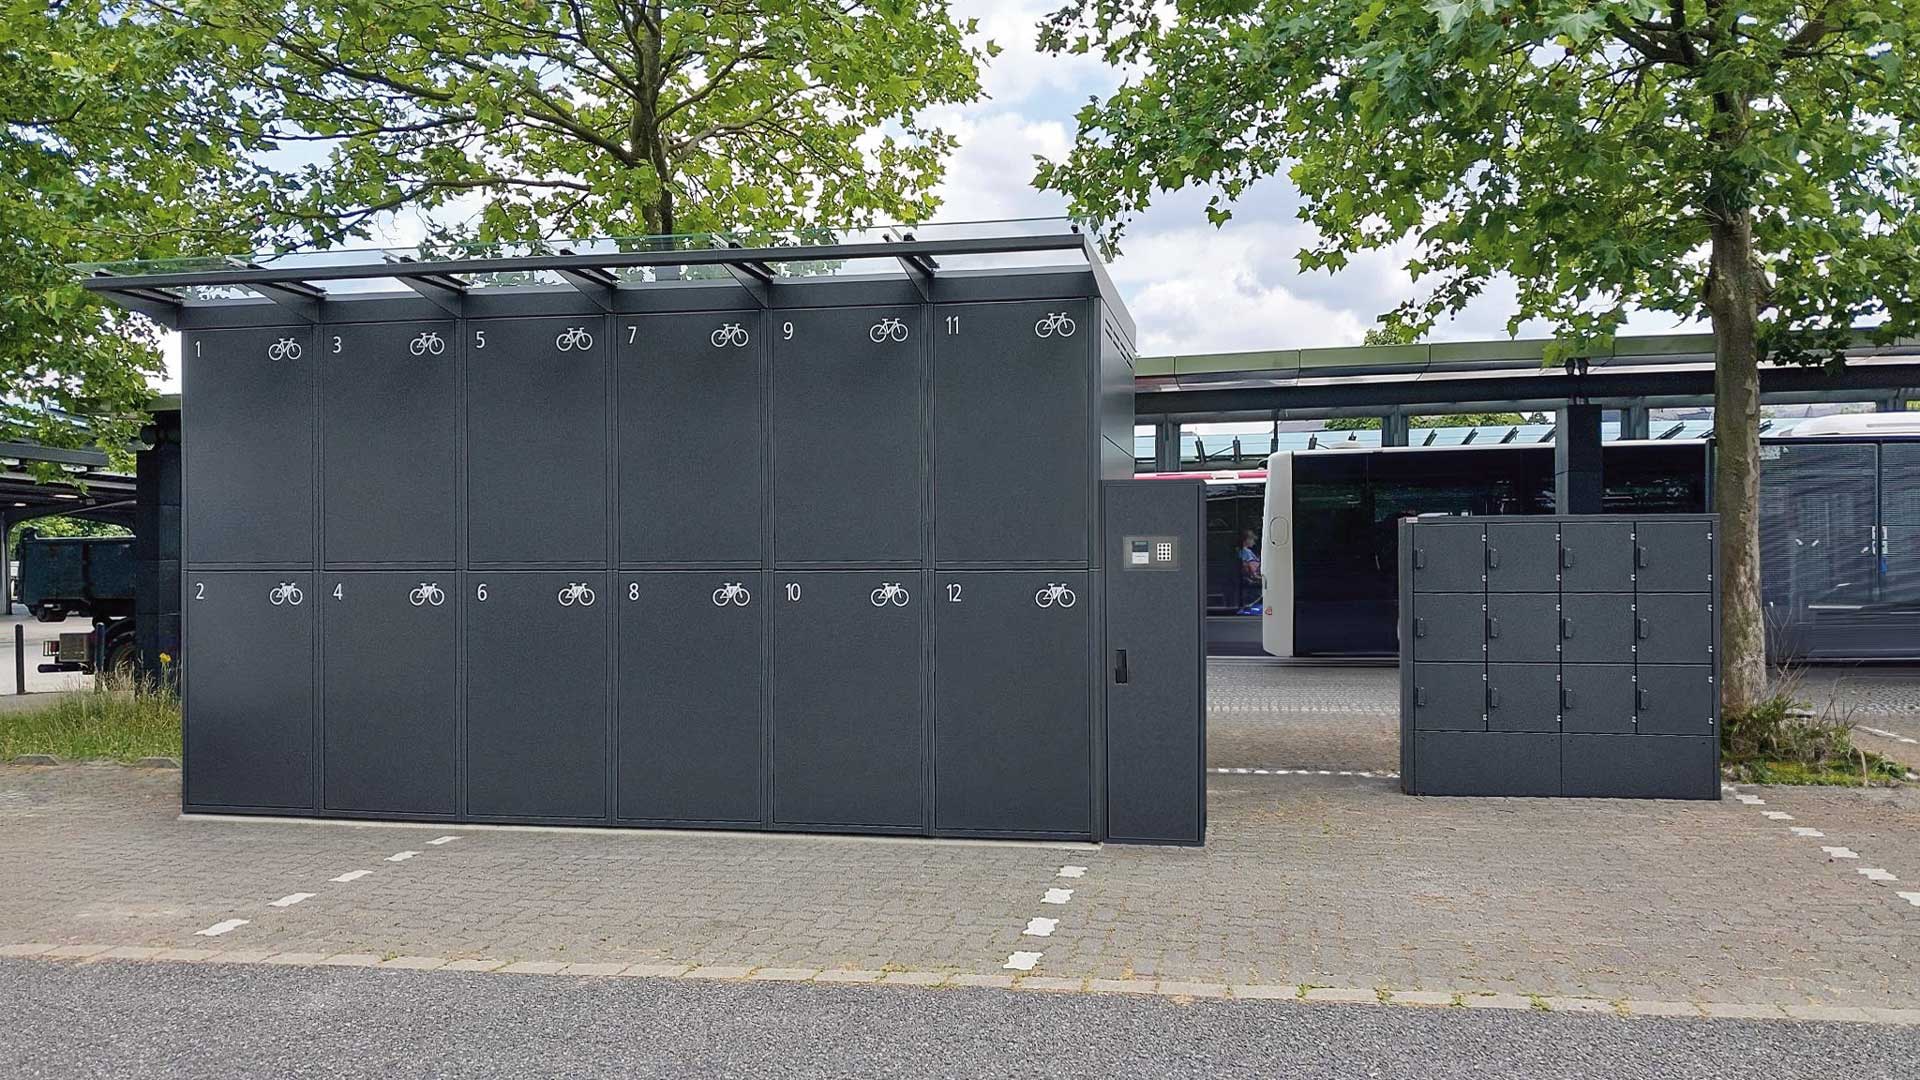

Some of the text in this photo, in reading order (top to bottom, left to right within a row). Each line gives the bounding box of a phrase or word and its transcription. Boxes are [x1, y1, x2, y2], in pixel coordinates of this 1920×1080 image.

[627, 326, 637, 344] 7
[783, 321, 794, 340] 9
[945, 316, 959, 335] 11
[195, 340, 201, 358] 1
[332, 335, 342, 354] 3
[476, 330, 486, 349] 5
[195, 582, 205, 600] 2
[332, 583, 344, 601] 4
[477, 583, 488, 602] 6
[628, 583, 640, 601] 8
[785, 583, 801, 602] 10
[946, 583, 962, 602] 12
